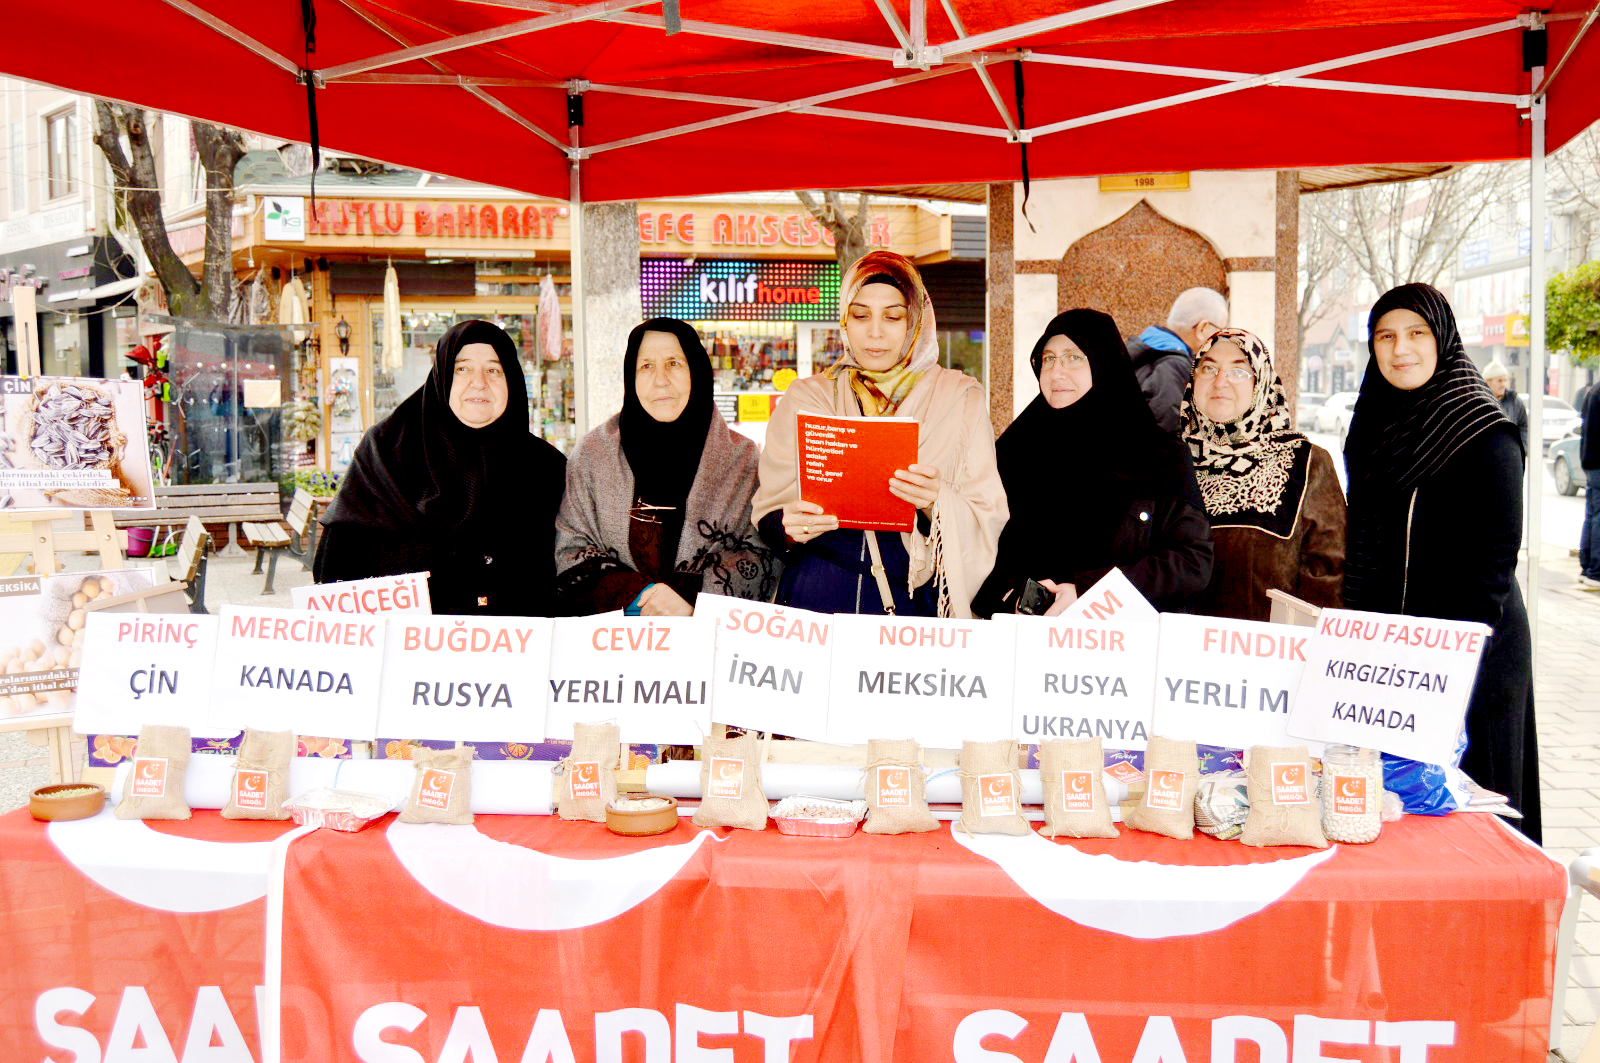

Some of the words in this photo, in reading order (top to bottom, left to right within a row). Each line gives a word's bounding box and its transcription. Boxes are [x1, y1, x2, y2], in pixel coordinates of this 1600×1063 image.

[1135, 178, 1154, 186] 1998
[309, 201, 404, 235] KUTLU
[415, 203, 559, 238] BAHARAT
[638, 212, 694, 244] EFE
[711, 213, 892, 248] AKSESR
[4, 378, 31, 393] ÇİN
[118, 617, 199, 649] PİRİNÇ
[231, 614, 376, 647] MERCİMEK
[403, 620, 534, 653] BUĞDAY
[591, 621, 671, 652] CEVİZ
[725, 608, 829, 646] SOĞAN
[879, 624, 973, 649] NOHUT
[1047, 625, 1126, 652] MISIR
[1319, 616, 1380, 642] KURU
[1383, 623, 1481, 653] FASULYE
[1202, 627, 1308, 662] FINDIK
[32, 681, 57, 691] ithal
[129, 663, 179, 700] ÇİN
[240, 664, 354, 695] KANADA
[549, 674, 624, 704] YERLİ
[633, 680, 707, 705] MALI
[728, 653, 804, 695] İRAN
[857, 668, 988, 699] MEKSİKA
[1043, 673, 1129, 698] RUSYA
[1325, 659, 1449, 694] KIRGIZİSTAN
[412, 681, 513, 708] RUSYA
[1164, 676, 1248, 710] YERLİ
[1022, 714, 1149, 742] UKRANYA
[1331, 701, 1416, 733] KANADA
[239, 790, 264, 799] SAADET
[422, 788, 447, 800] SAADET
[573, 782, 598, 790] SAADET
[880, 788, 908, 797] SAADET
[983, 795, 1011, 805] SAADET
[1066, 793, 1091, 801] SAADET
[1152, 789, 1181, 799] SAADET
[1335, 796, 1365, 805] SAADET
[1337, 804, 1363, 813] İNEGÖL
[35, 986, 267, 1063] SAA
